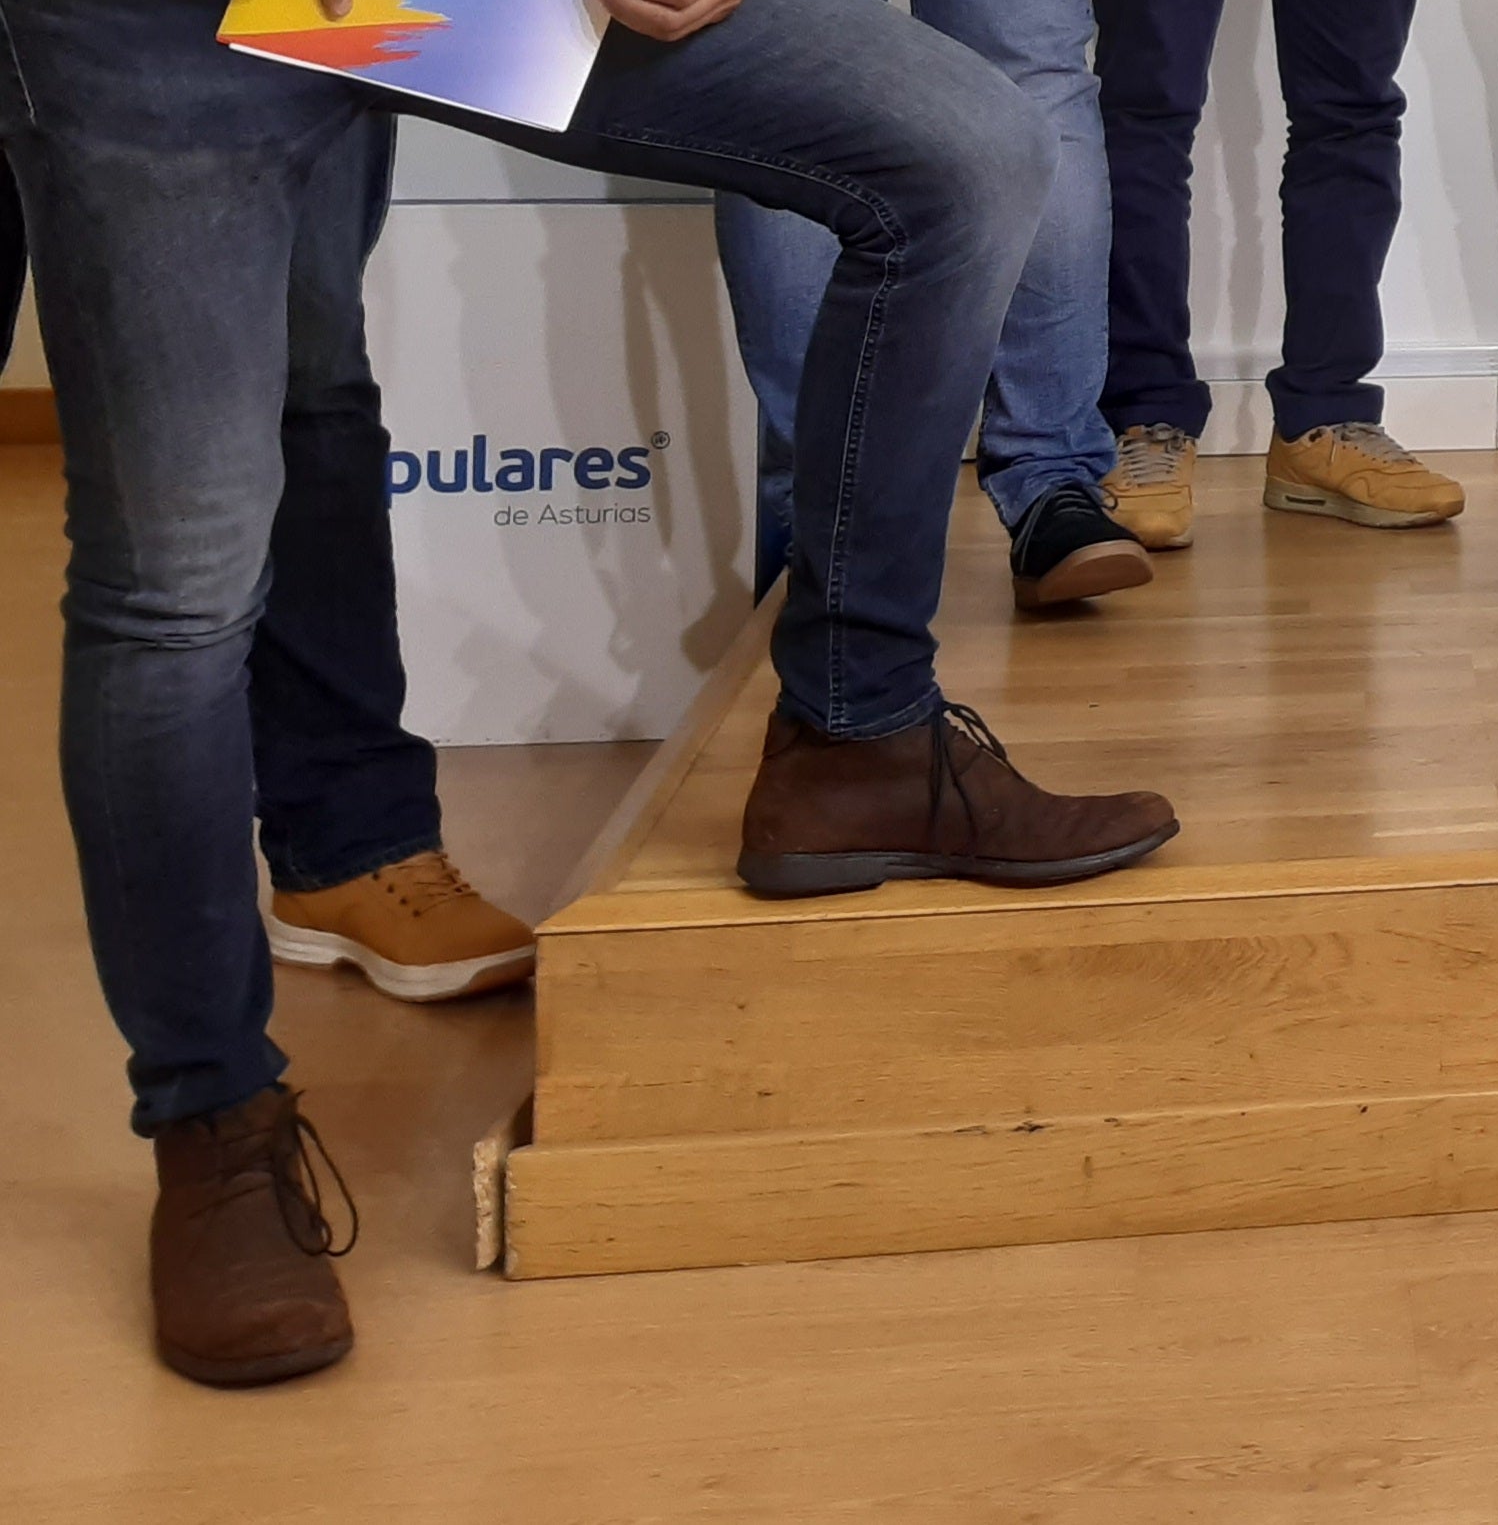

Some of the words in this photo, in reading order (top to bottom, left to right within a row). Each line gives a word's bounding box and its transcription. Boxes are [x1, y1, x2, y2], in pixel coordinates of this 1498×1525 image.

[386, 434, 651, 509] pulares
[494, 505, 528, 526] de
[538, 503, 651, 525] Asturias
